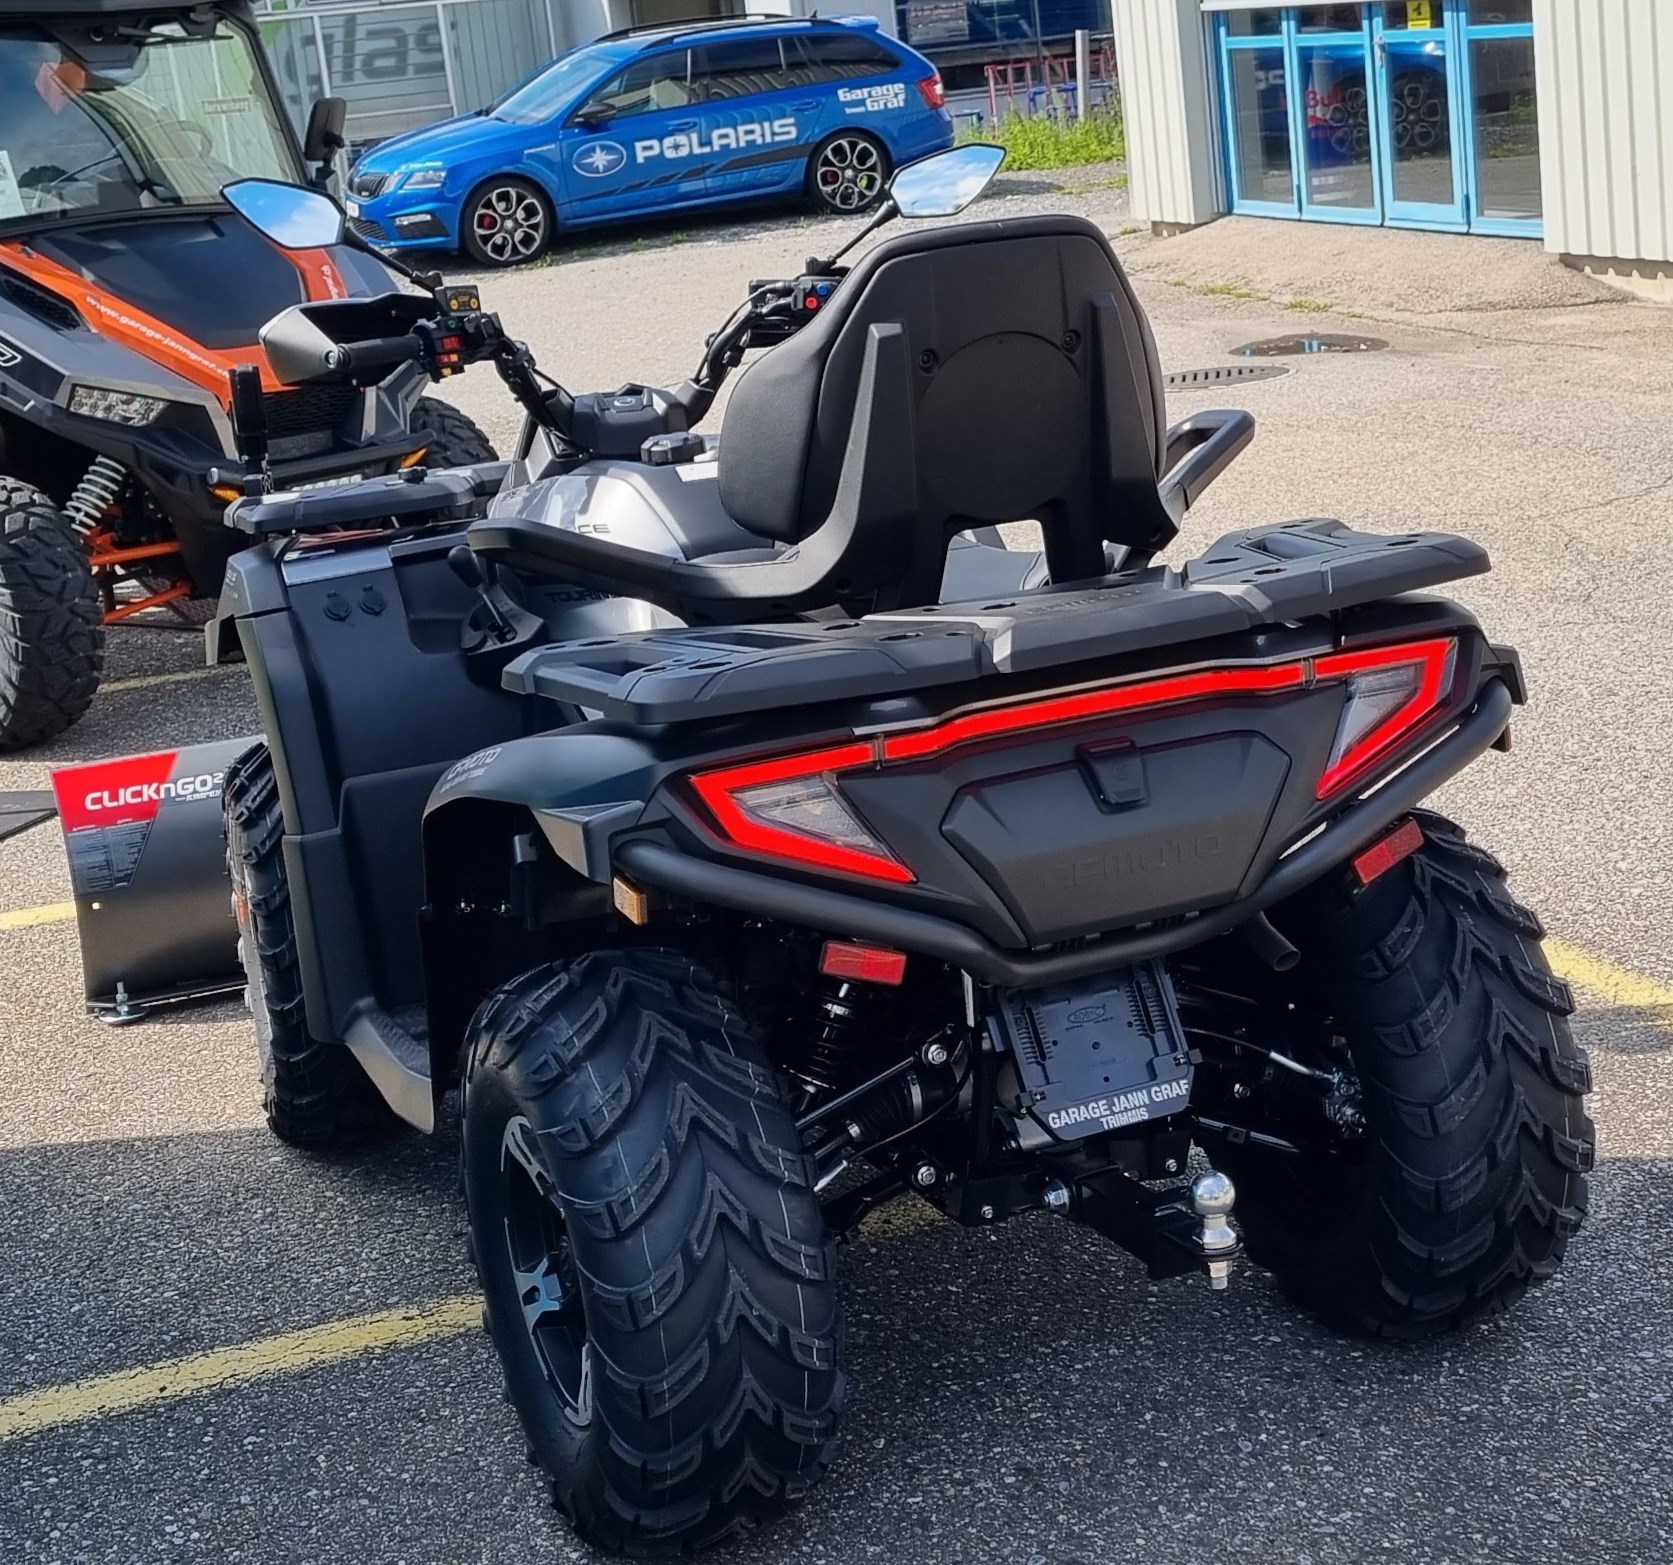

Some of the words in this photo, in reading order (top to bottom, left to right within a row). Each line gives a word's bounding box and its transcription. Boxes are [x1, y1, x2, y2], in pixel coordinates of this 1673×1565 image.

[837, 83, 905, 101] Garage
[865, 93, 906, 111] Graf
[634, 117, 797, 164] POLARIS
[1048, 1100, 1110, 1129] GARAGE
[1111, 1090, 1150, 1113] JANN
[1151, 1079, 1190, 1102] GRAF
[1100, 1107, 1149, 1130] TRIMMIS
